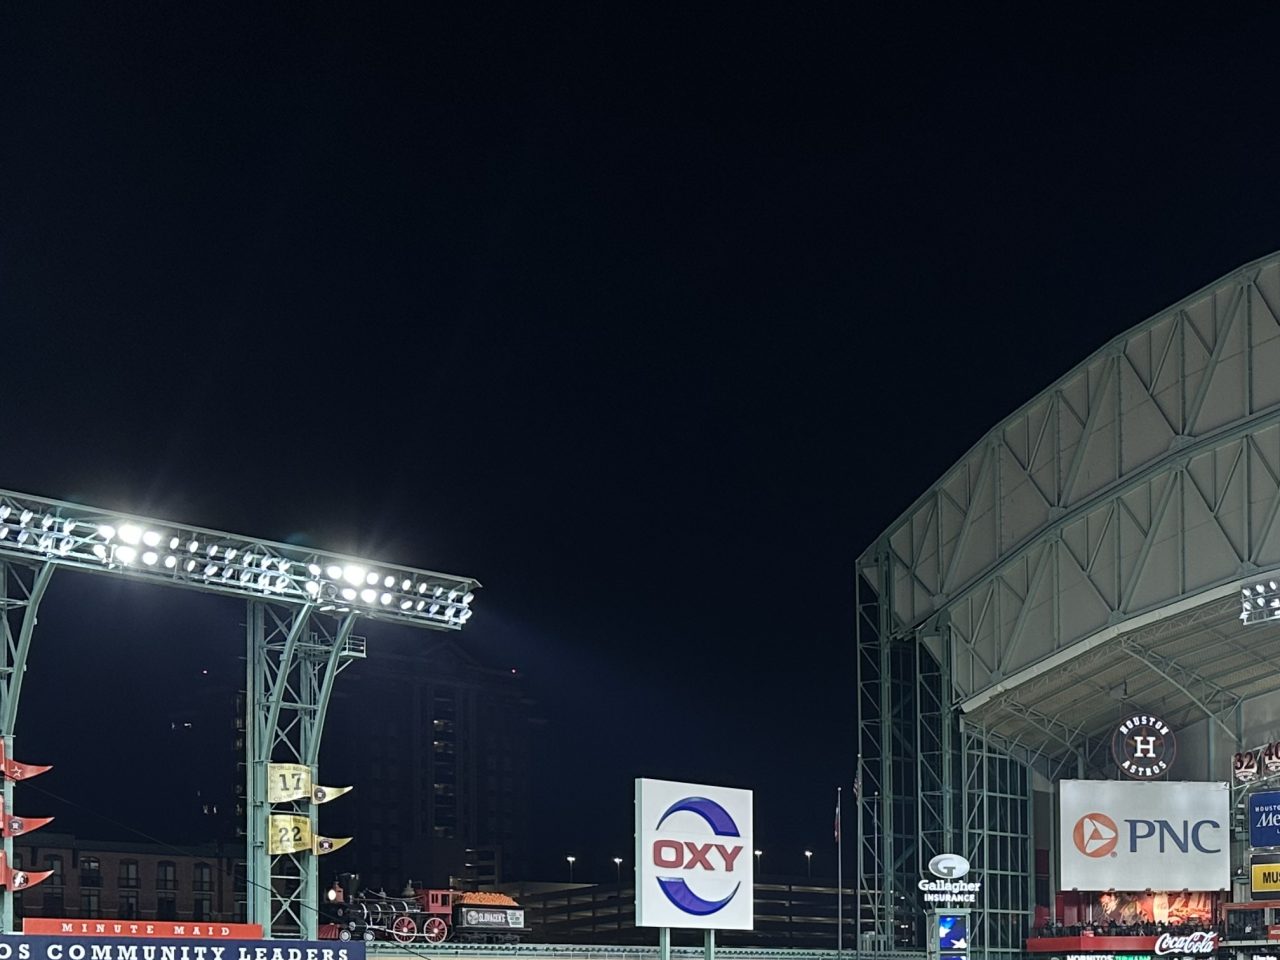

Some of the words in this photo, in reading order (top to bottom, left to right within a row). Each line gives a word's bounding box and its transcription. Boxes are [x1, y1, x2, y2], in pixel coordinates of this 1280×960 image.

[1119, 715, 1170, 736] HOUSTON
[1133, 736, 1156, 758] H
[1121, 760, 1168, 777] ASTROS
[1234, 752, 1255, 770] 32
[279, 773, 303, 792] 17
[279, 826, 303, 844] 22
[1124, 819, 1221, 853] PNC
[652, 839, 744, 872] OXY
[918, 879, 981, 894] Gallagher
[924, 893, 975, 902] INSURANCE
[62, 923, 154, 935] MINUTE
[174, 924, 230, 936] MAID
